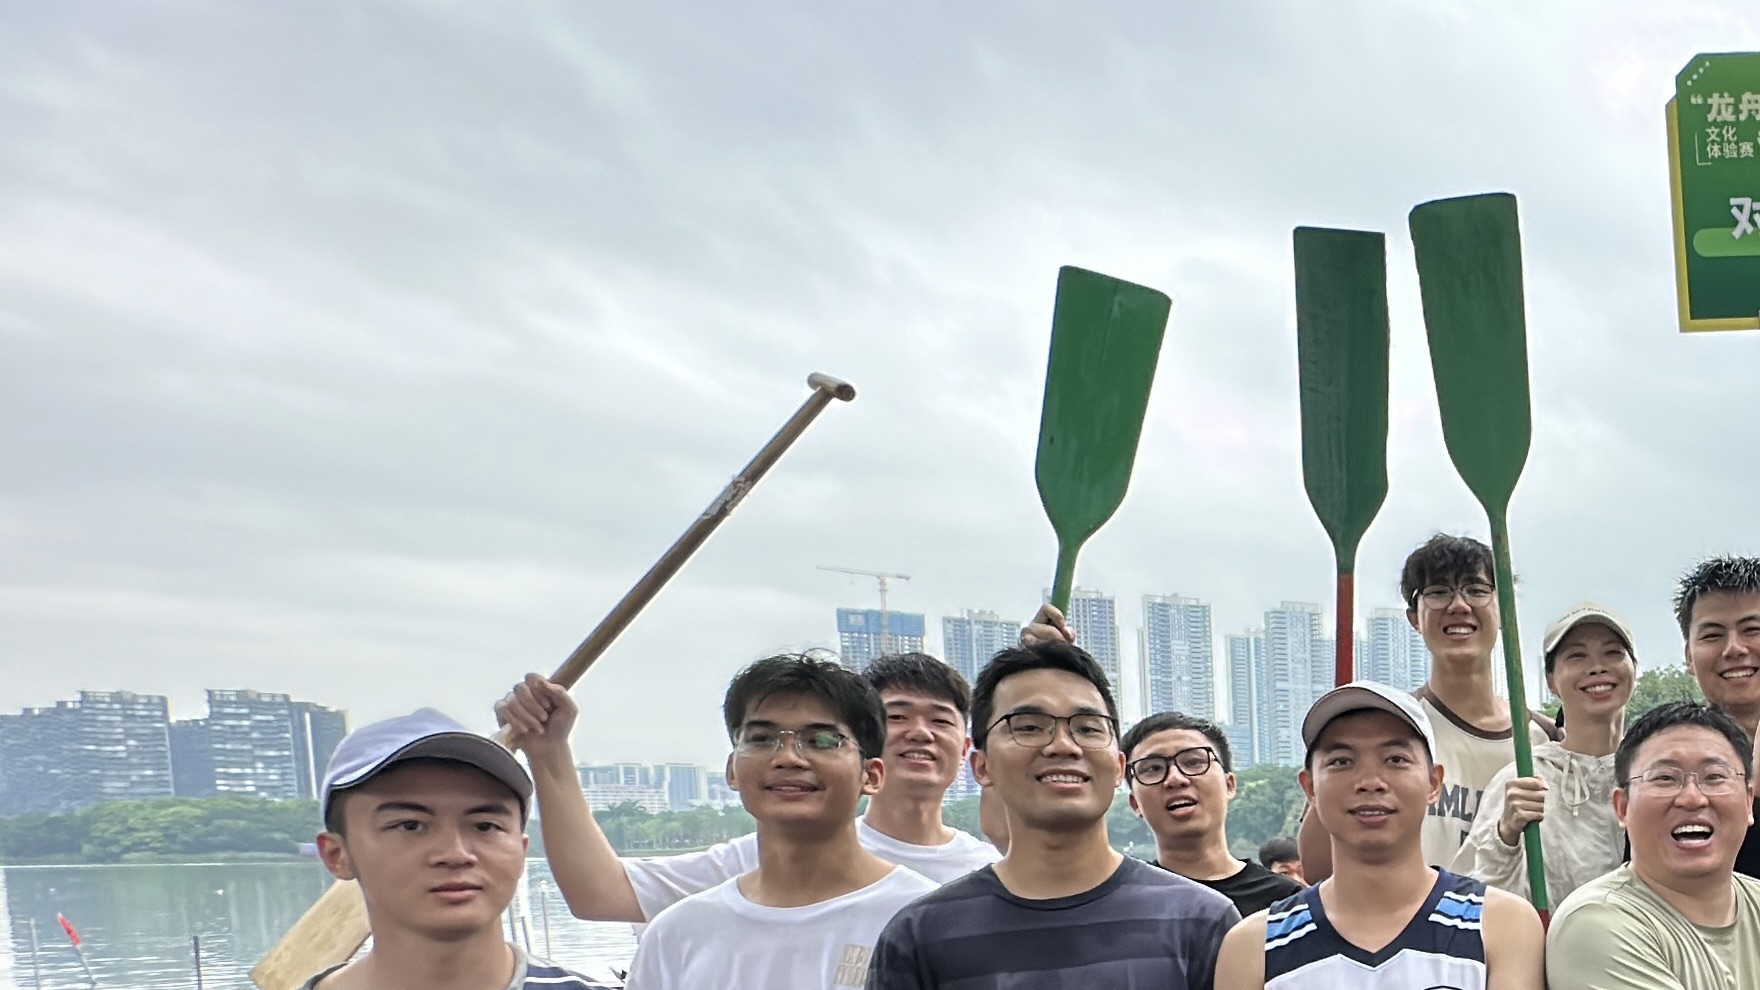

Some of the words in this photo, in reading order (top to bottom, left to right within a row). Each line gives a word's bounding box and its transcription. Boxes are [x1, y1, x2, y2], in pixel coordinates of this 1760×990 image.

[1705, 126, 1737, 142] 文化
[1706, 142, 1754, 159] 体验赛
